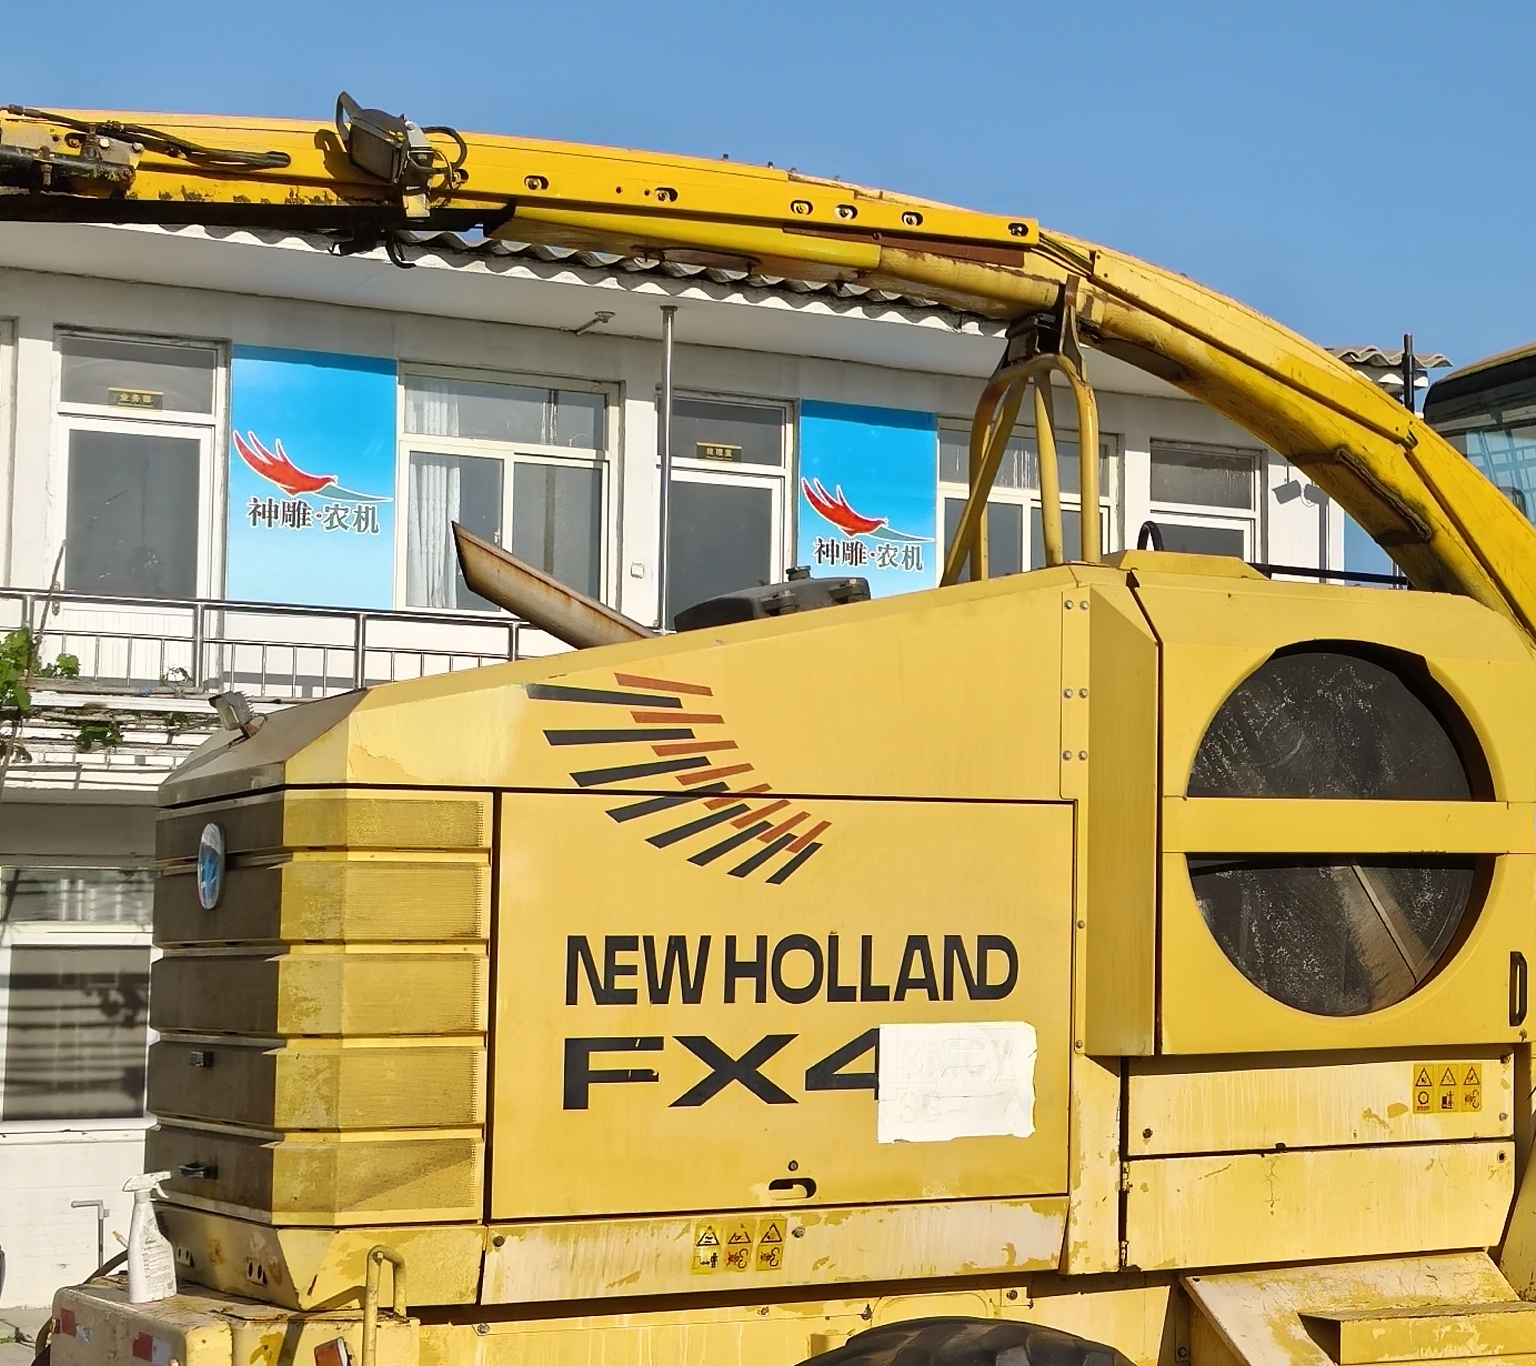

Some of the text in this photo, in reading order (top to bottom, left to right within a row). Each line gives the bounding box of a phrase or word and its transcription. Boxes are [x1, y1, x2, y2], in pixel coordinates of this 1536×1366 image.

[248, 497, 379, 534] 神雕·农机
[814, 538, 923, 571] 神雕·农机
[565, 933, 1018, 1005] NEW HOLLAND
